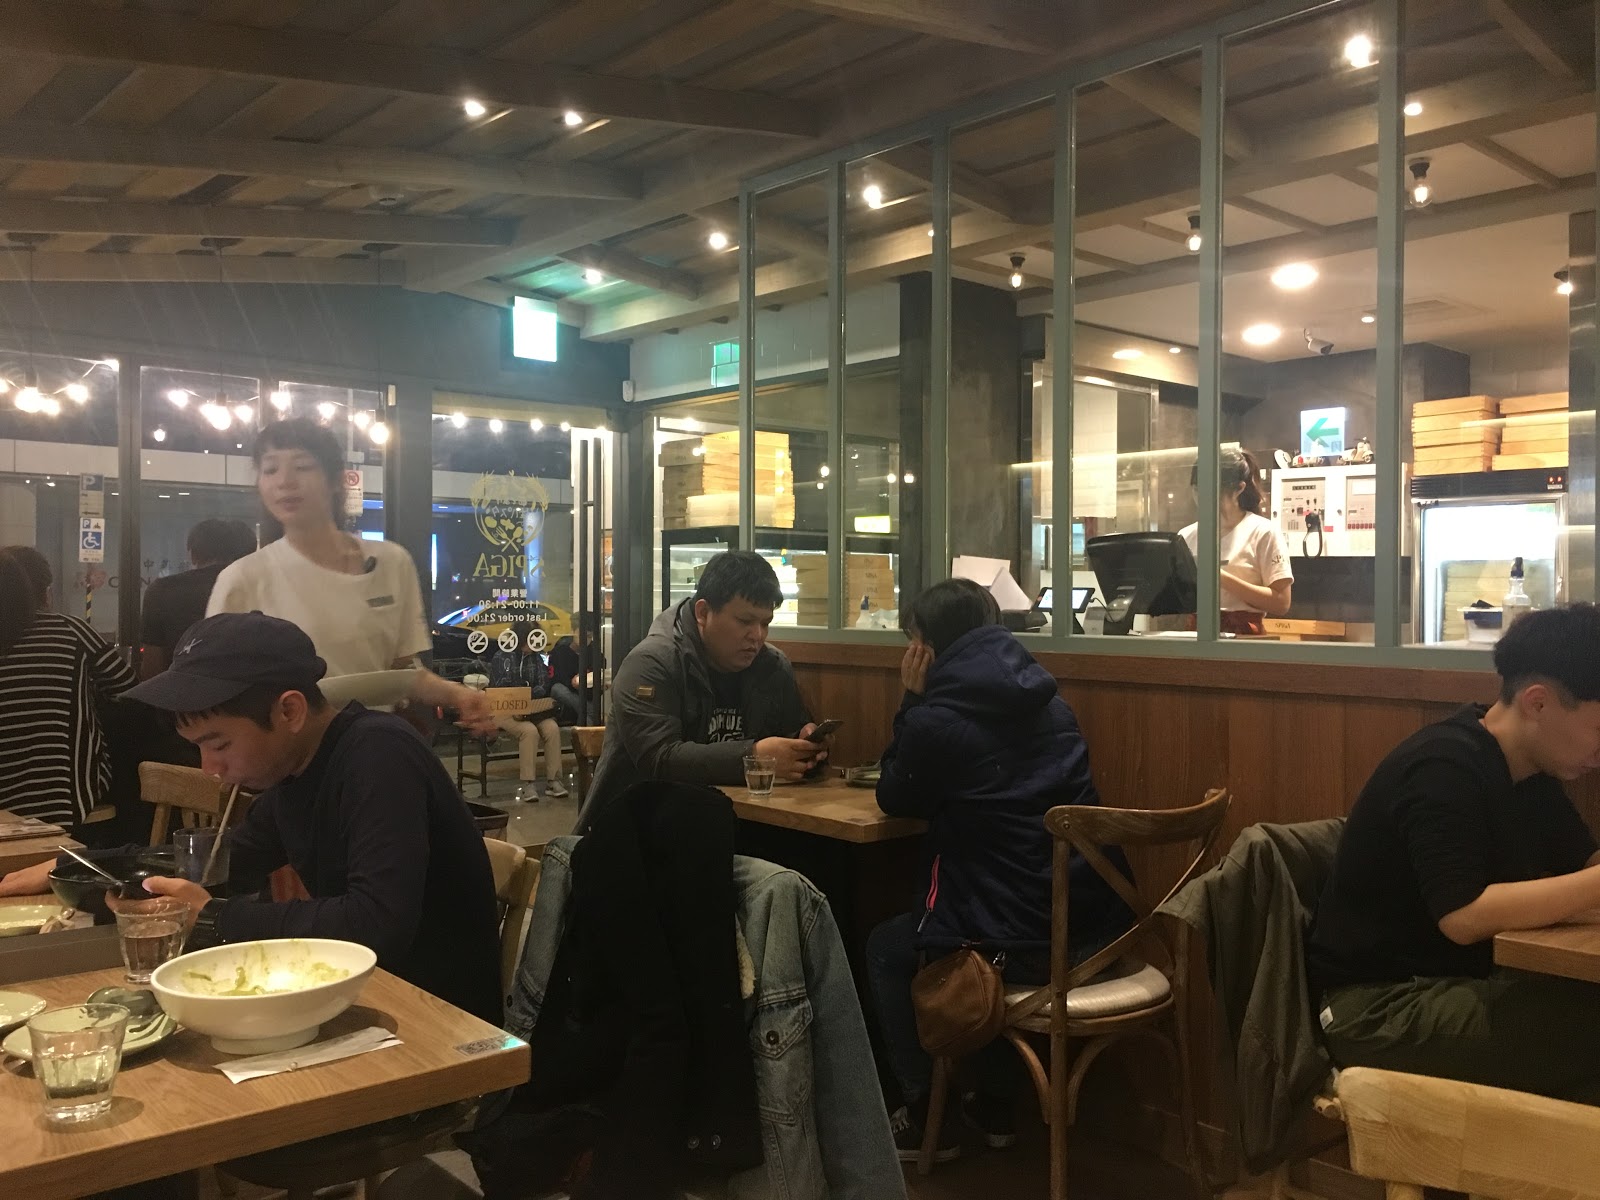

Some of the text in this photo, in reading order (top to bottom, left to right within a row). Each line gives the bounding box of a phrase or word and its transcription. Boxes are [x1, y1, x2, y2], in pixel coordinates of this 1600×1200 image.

[82, 476, 96, 490] P
[83, 519, 90, 528] P
[489, 699, 528, 711] CLOSED
